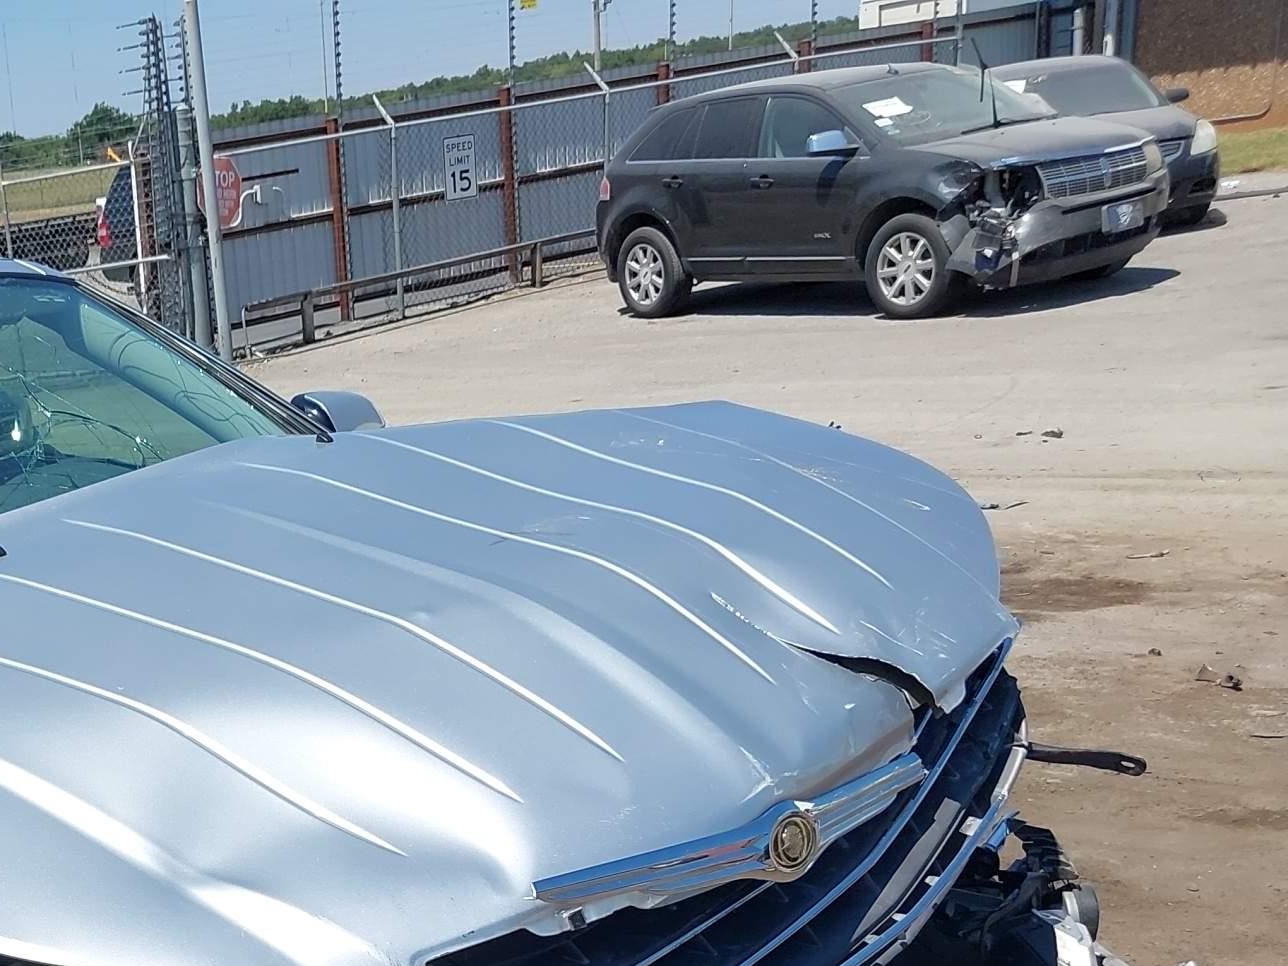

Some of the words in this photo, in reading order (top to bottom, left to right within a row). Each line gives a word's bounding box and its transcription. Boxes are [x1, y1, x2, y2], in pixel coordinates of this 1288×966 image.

[446, 140, 473, 154] SPEED
[449, 154, 470, 167] LIMIT
[215, 170, 235, 188] TOP
[451, 169, 472, 194] 15
